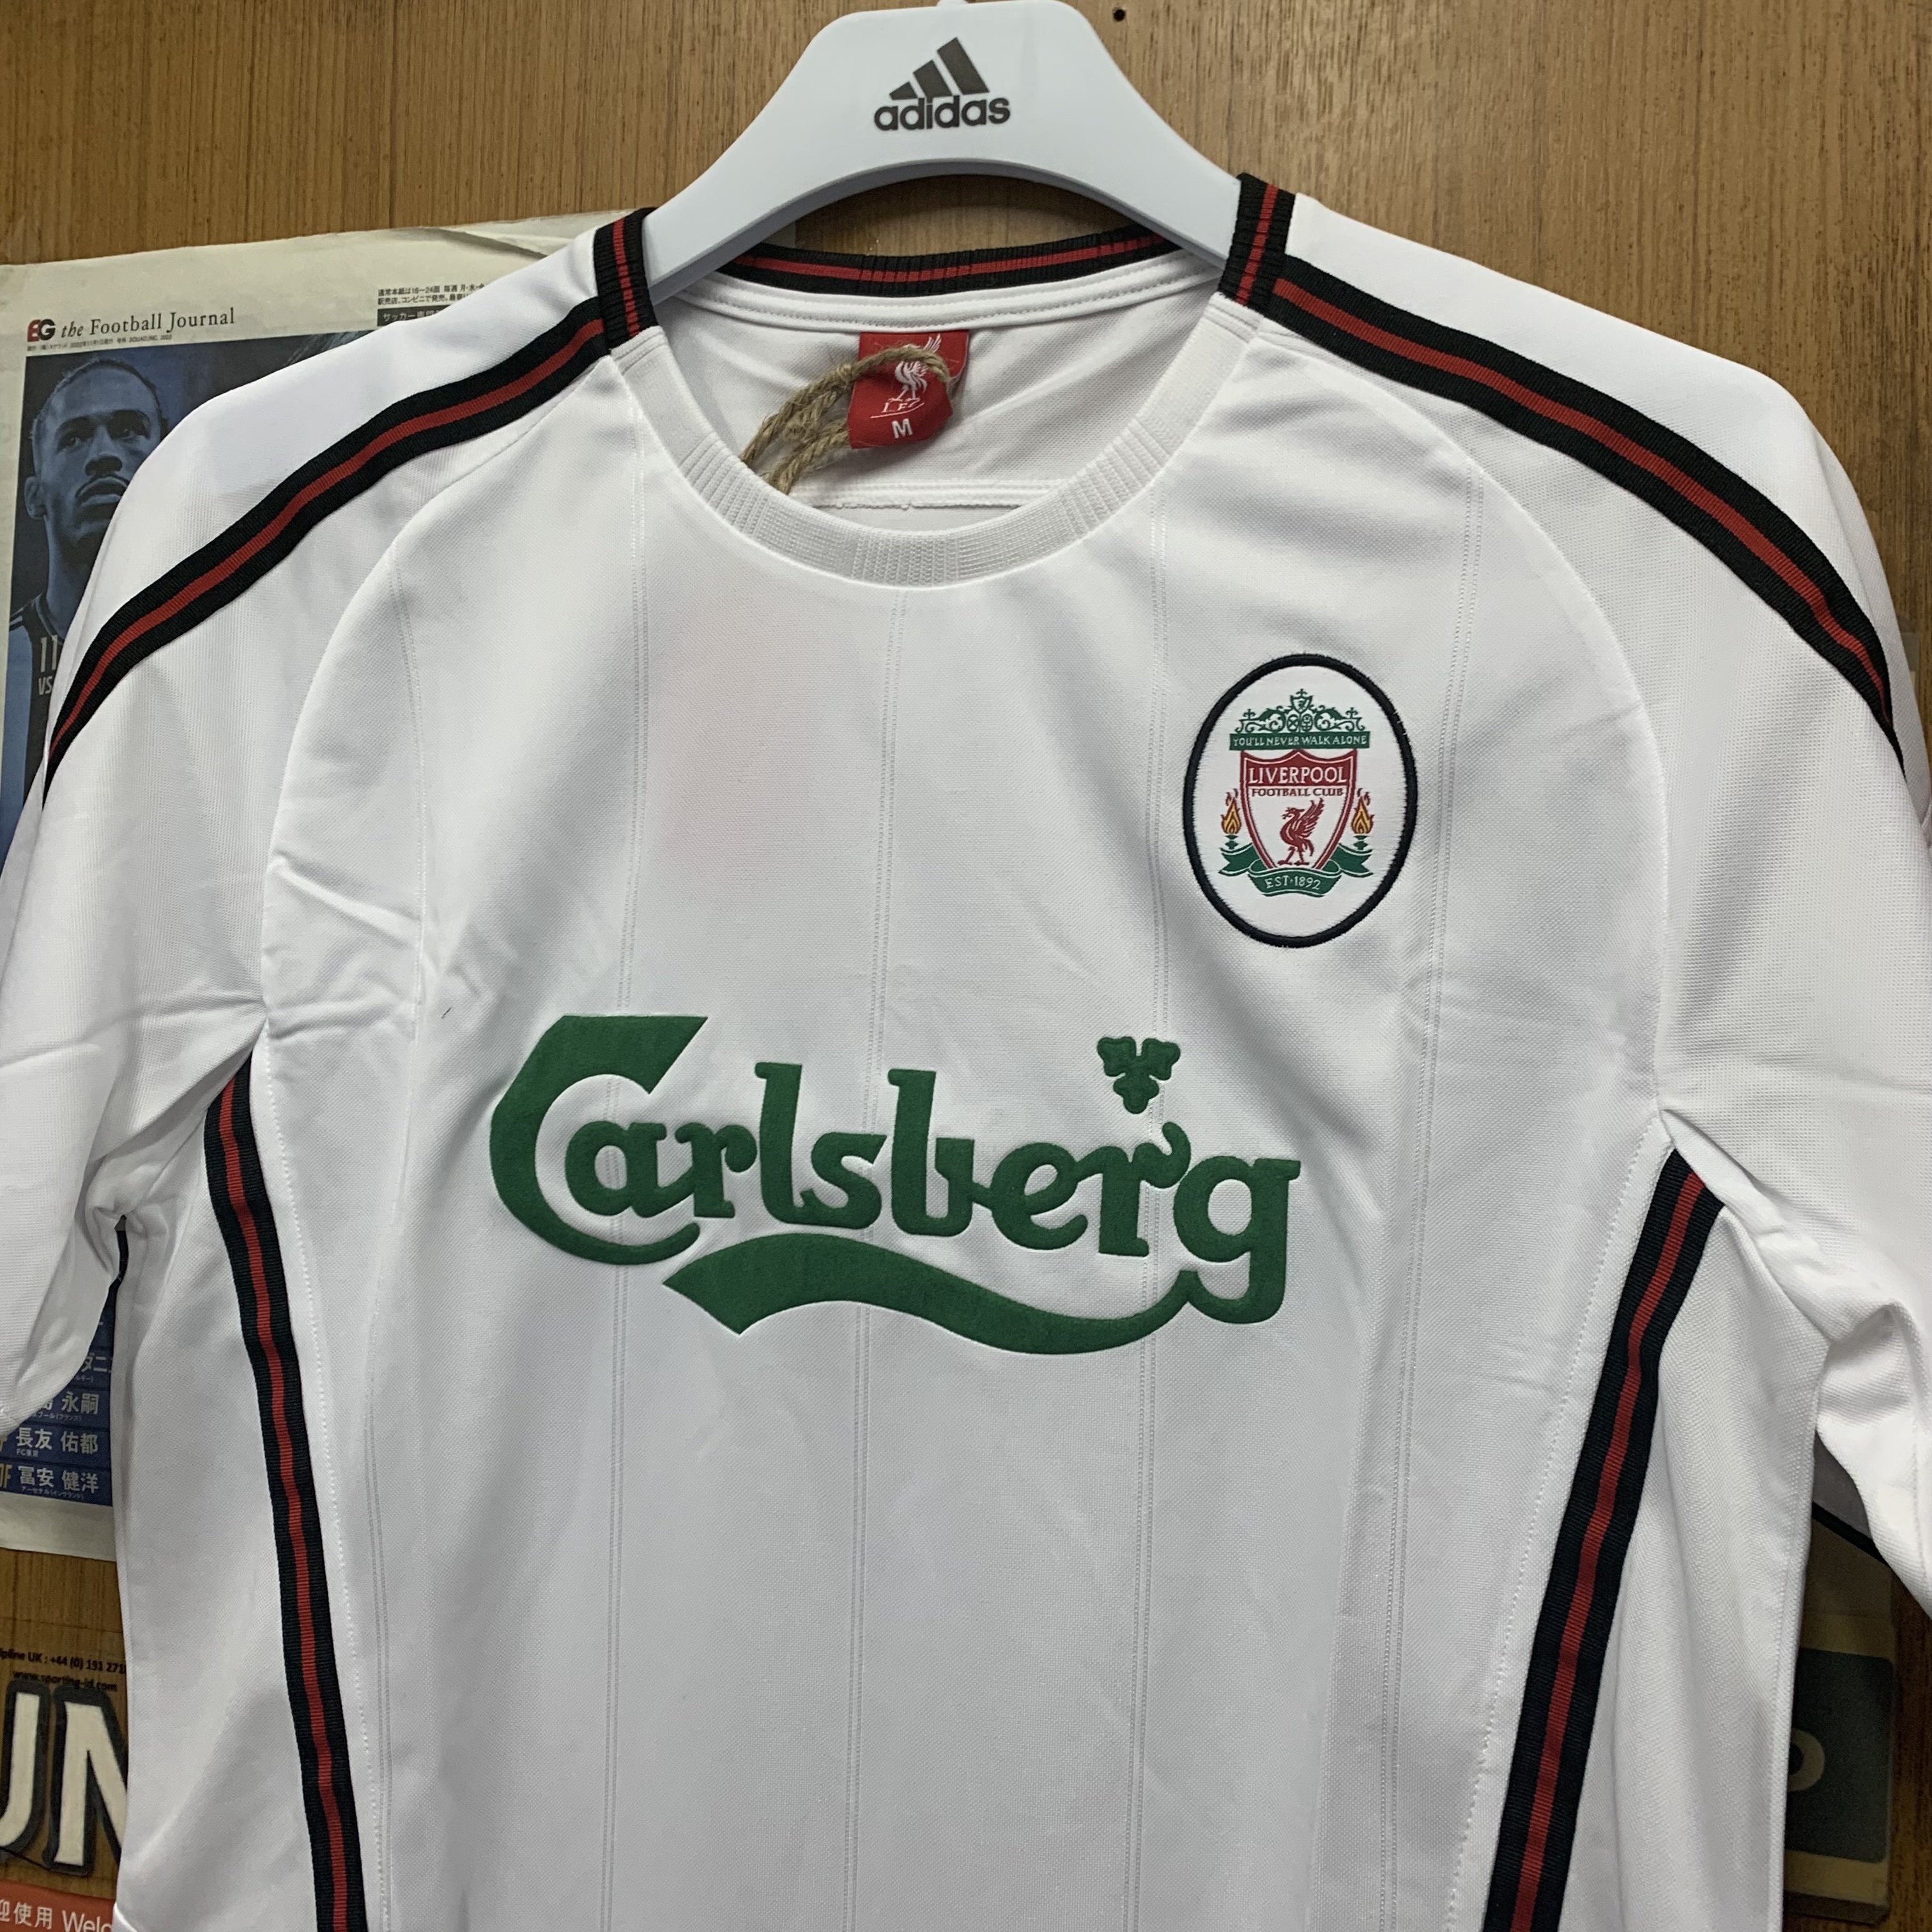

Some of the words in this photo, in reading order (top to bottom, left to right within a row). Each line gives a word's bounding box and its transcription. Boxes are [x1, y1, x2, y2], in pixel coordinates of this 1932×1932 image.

[874, 95, 1011, 131] adidas
[27, 318, 56, 342] EG
[61, 321, 84, 338] the
[90, 312, 162, 335] Football
[166, 307, 235, 334] Journal
[891, 418, 913, 439] M
[1233, 737, 1265, 747] YOU'LL
[1266, 737, 1300, 746] NEVER
[1301, 735, 1328, 746] WALK
[1332, 735, 1367, 746] ALONE
[1248, 766, 1347, 785] LIVERPOOL
[1251, 788, 1310, 797] FOOTBALL
[1312, 788, 1344, 797] CLUB
[490, 1015, 1301, 1324] Carlsberg
[15, 1427, 53, 1450] 長友
[61, 1430, 99, 1455] 佑都
[61, 1469, 100, 1494] 健洋
[28, 1652, 43, 1664] UK
[70, 1656, 84, 1671] (0)
